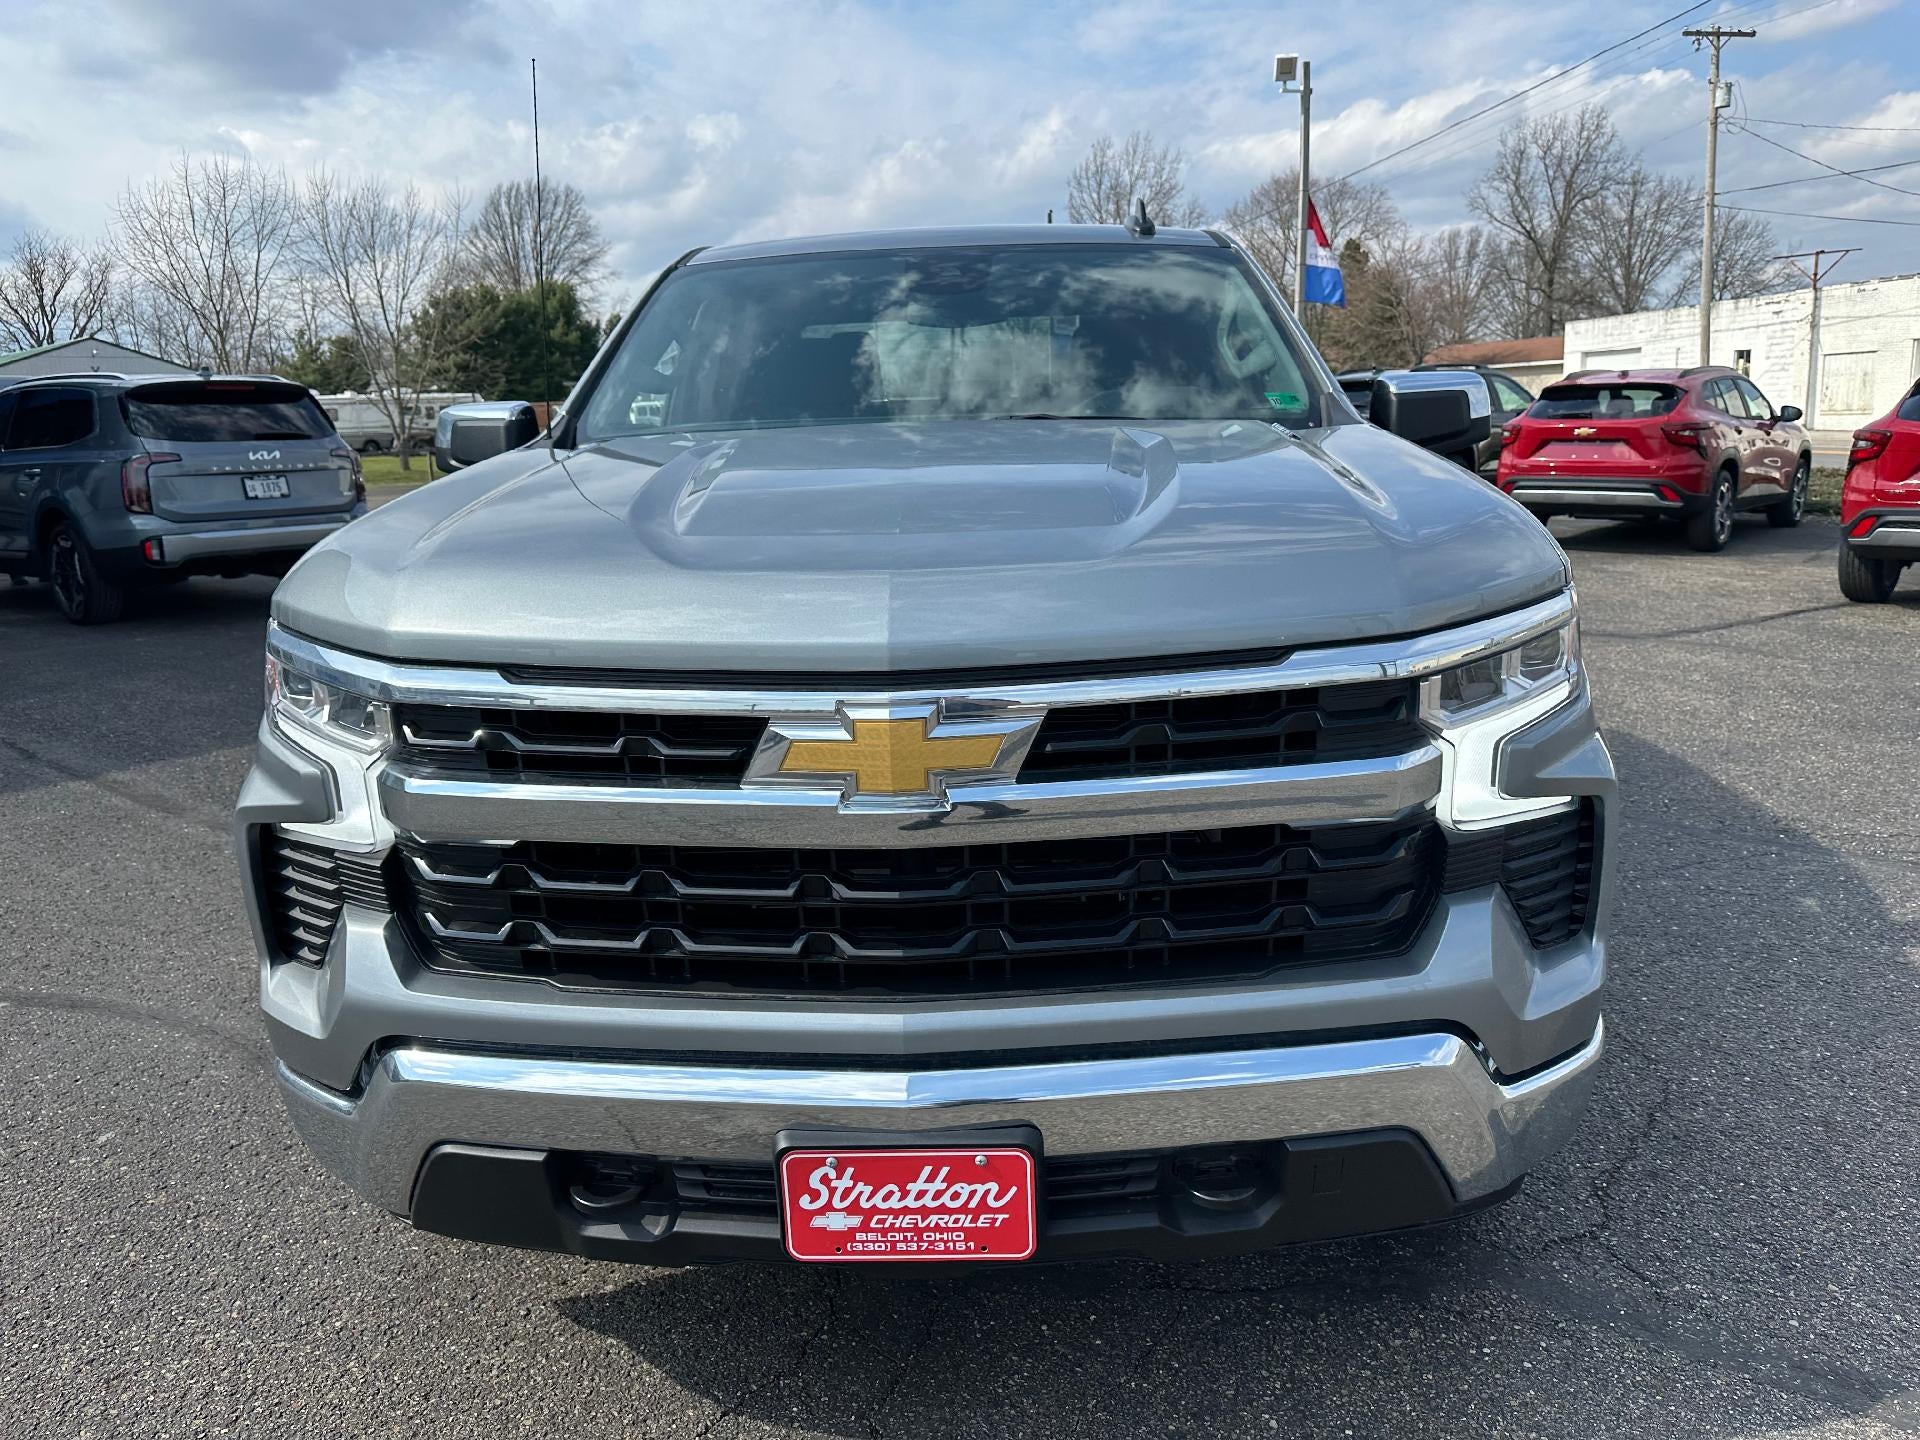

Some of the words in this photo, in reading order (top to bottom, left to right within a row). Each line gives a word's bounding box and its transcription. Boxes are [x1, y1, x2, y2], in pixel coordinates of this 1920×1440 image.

[799, 1166, 1018, 1210] Stratton
[870, 1214, 1009, 1228] CHEVROLET
[855, 1232, 917, 1241] BELOIT,
[923, 1231, 965, 1241] OHIO
[847, 1242, 891, 1252] (330)
[896, 1241, 975, 1251] 537-3151
